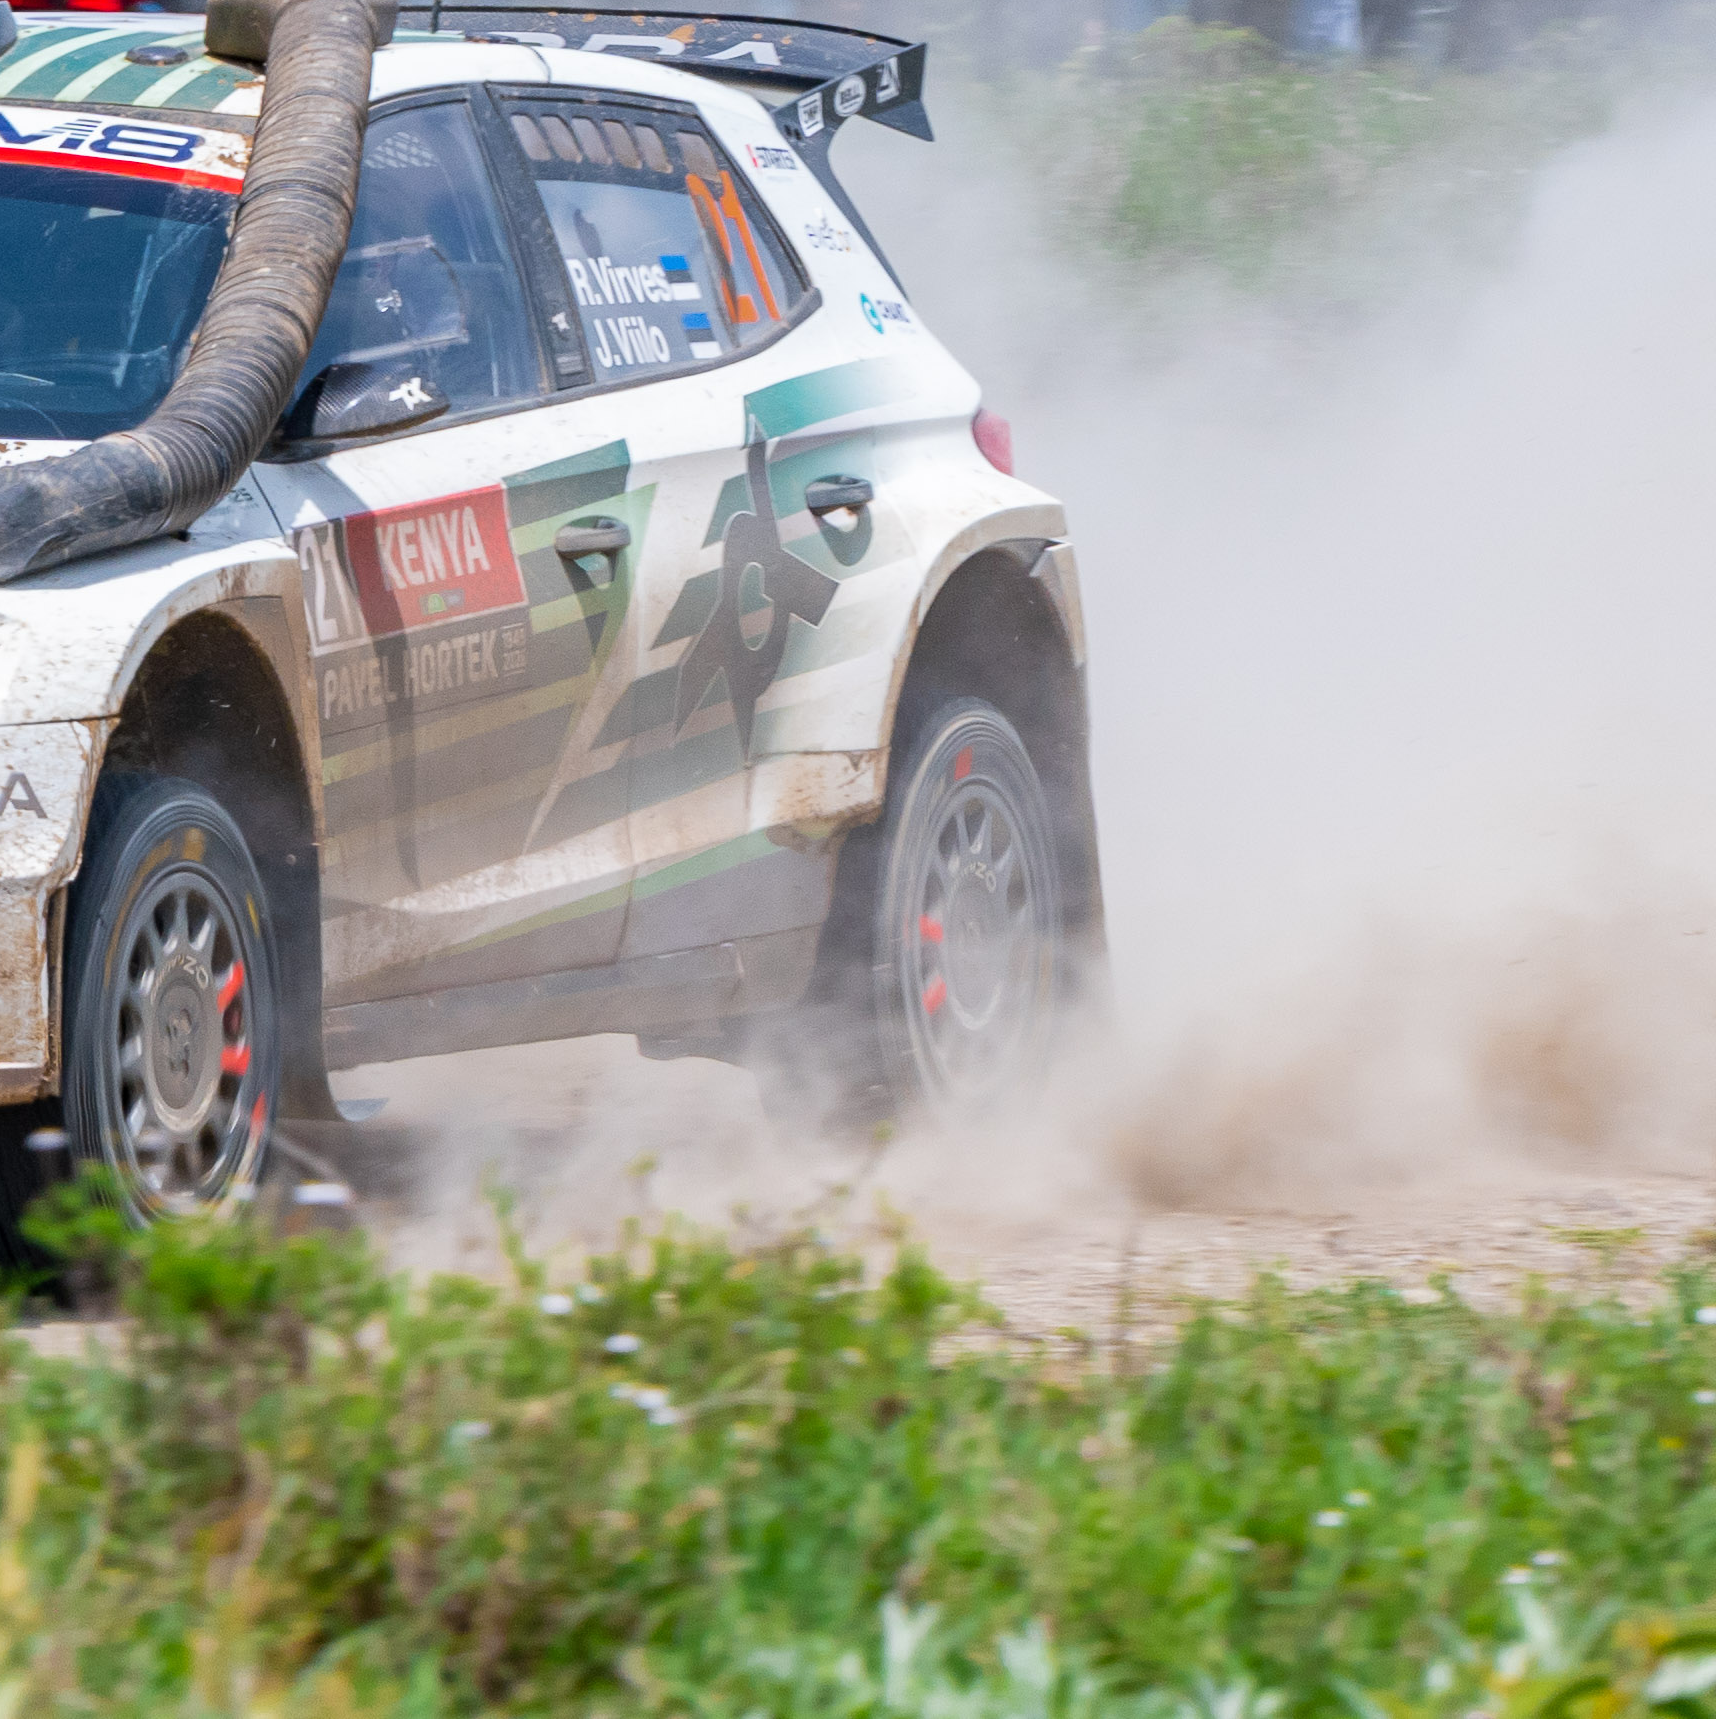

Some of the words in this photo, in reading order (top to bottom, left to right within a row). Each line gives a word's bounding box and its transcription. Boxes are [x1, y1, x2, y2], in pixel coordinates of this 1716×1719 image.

[566, 257, 674, 306] R.Virves
[685, 170, 781, 323] 21
[594, 316, 670, 368] J.Viilo
[298, 521, 354, 642] 21
[375, 506, 491, 591] KENYA
